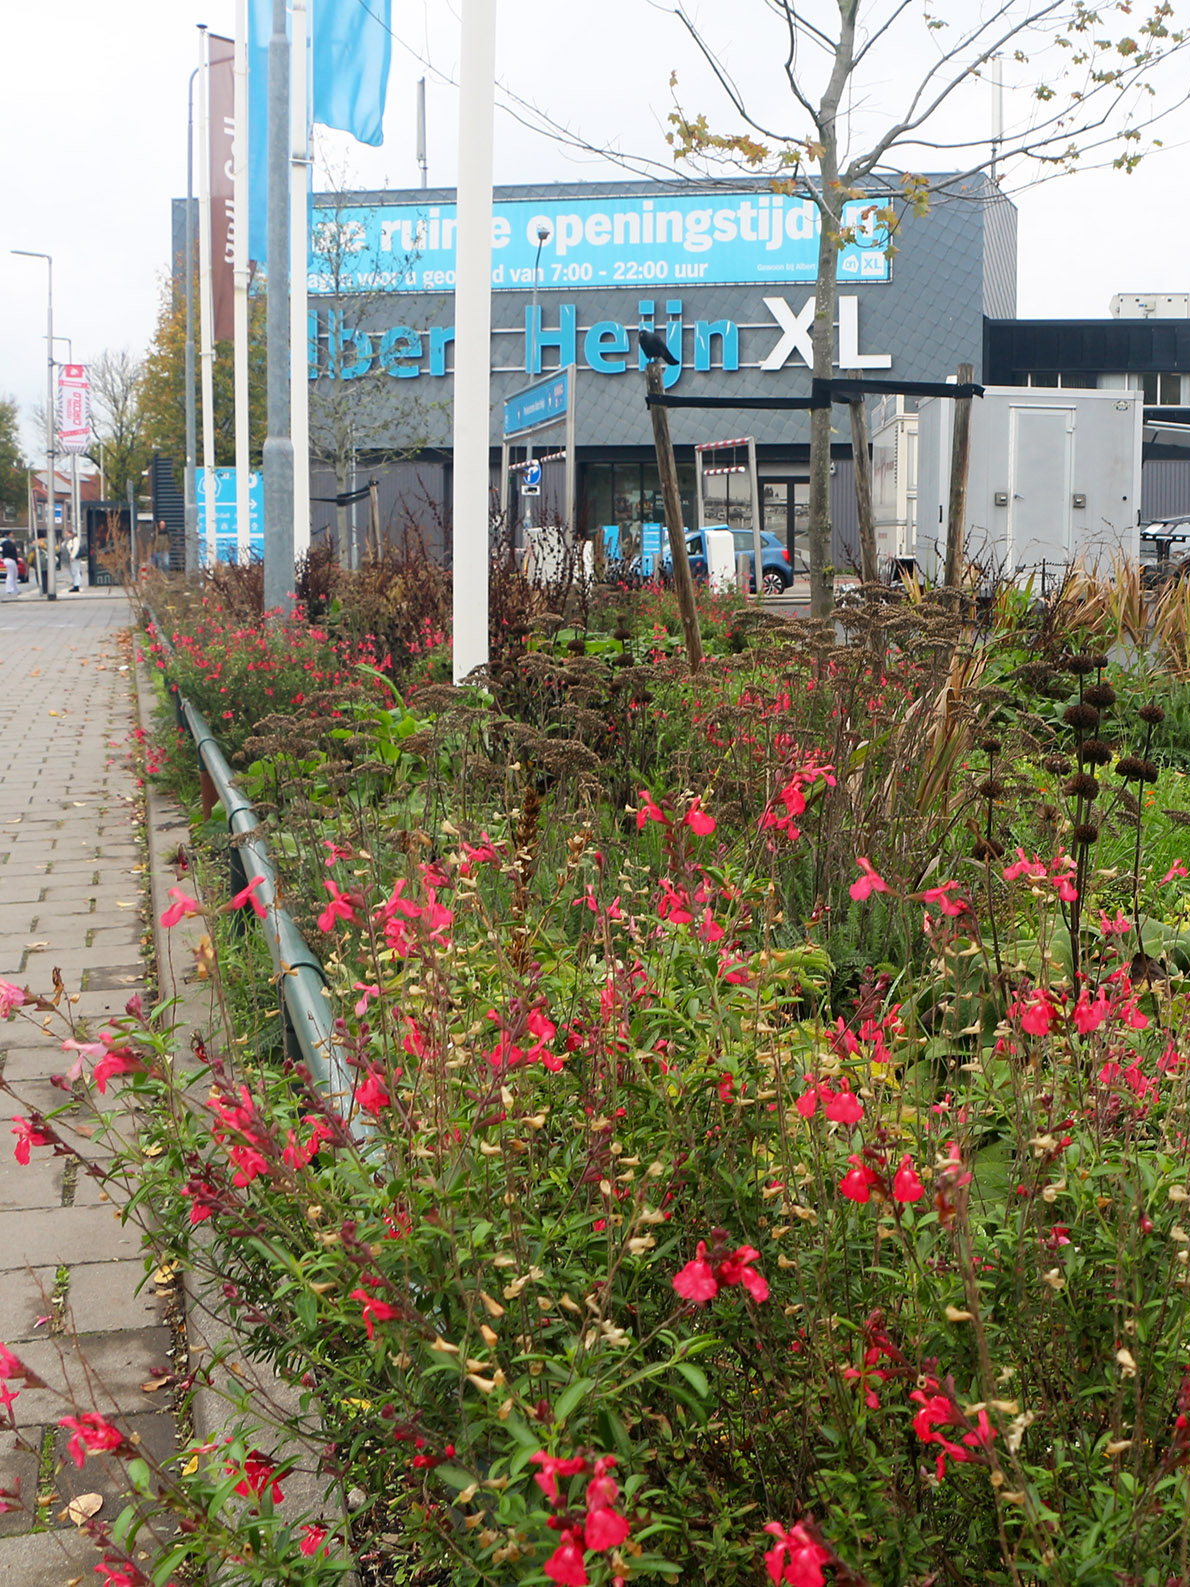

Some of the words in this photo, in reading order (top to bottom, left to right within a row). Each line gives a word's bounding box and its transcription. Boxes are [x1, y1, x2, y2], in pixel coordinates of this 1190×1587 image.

[526, 196, 874, 256] openingstijdn
[404, 270, 416, 285] u
[510, 267, 544, 283] van
[551, 263, 593, 281] 7:00
[613, 261, 668, 279] 22:00
[674, 261, 708, 278] uur
[863, 258, 883, 270] XL
[525, 300, 739, 389] Heijn
[760, 296, 892, 371] XL
